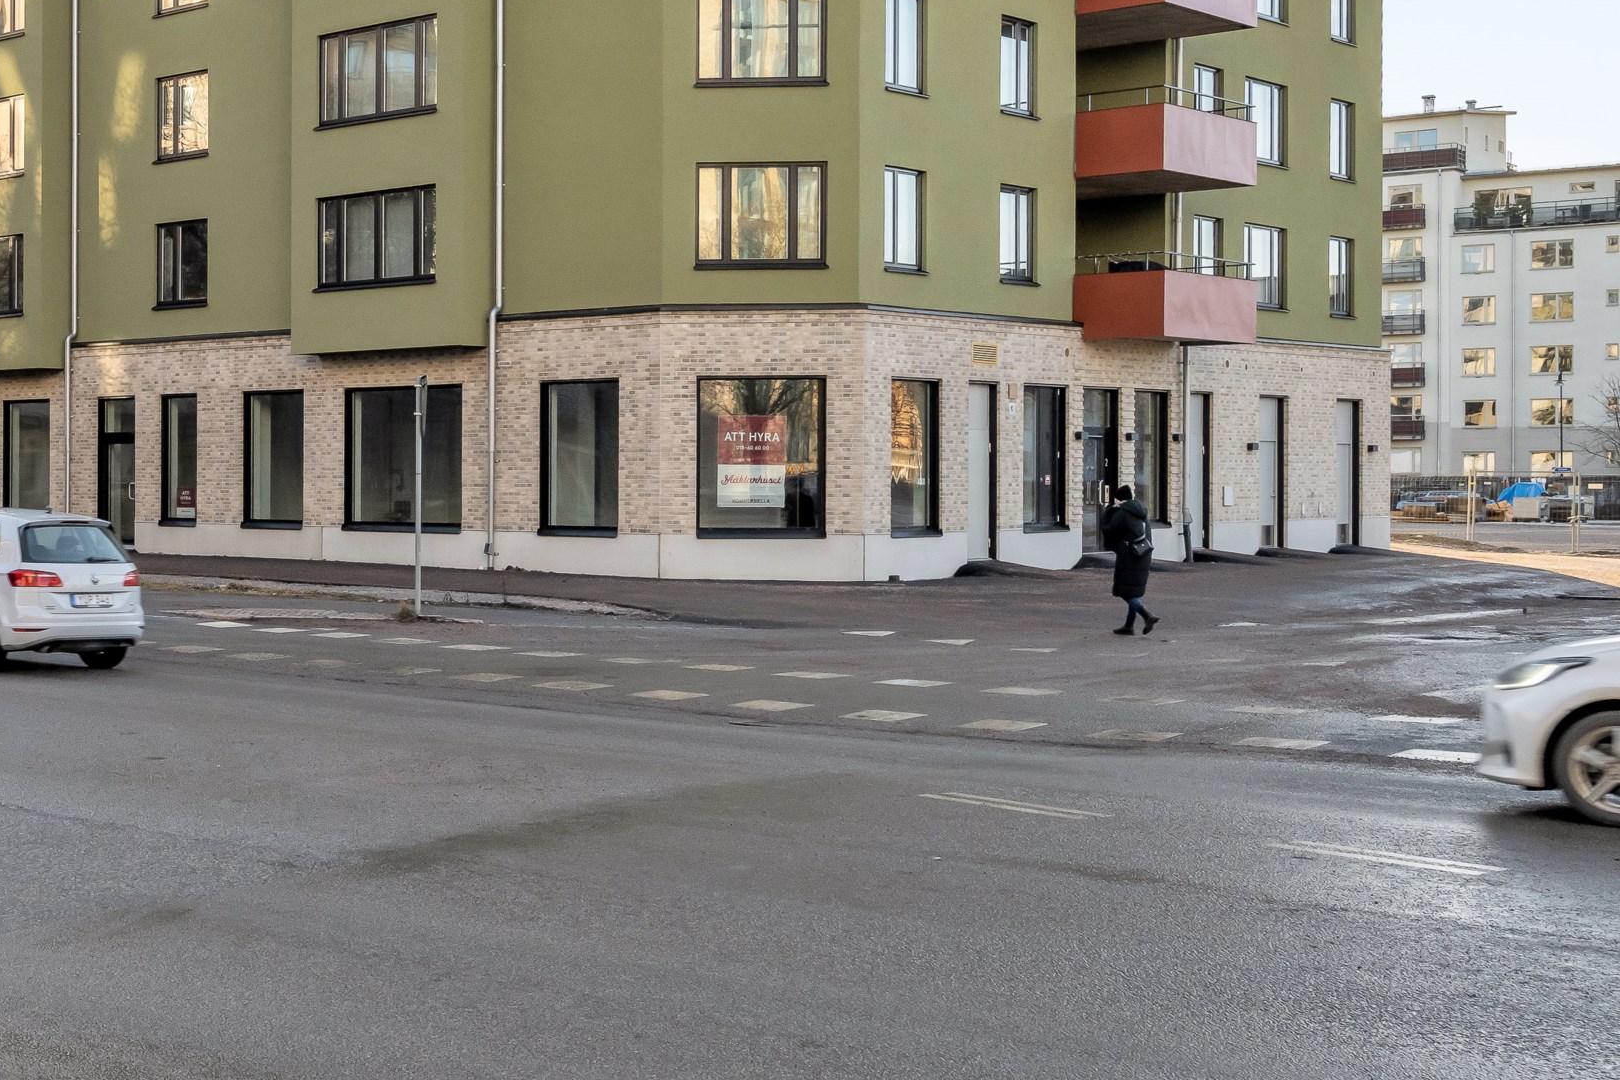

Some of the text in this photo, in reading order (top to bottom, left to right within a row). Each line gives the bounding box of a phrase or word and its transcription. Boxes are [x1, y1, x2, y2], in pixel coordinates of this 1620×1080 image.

[724, 431, 780, 441] ATT HYRA
[721, 475, 782, 485] Mäklarhuset
